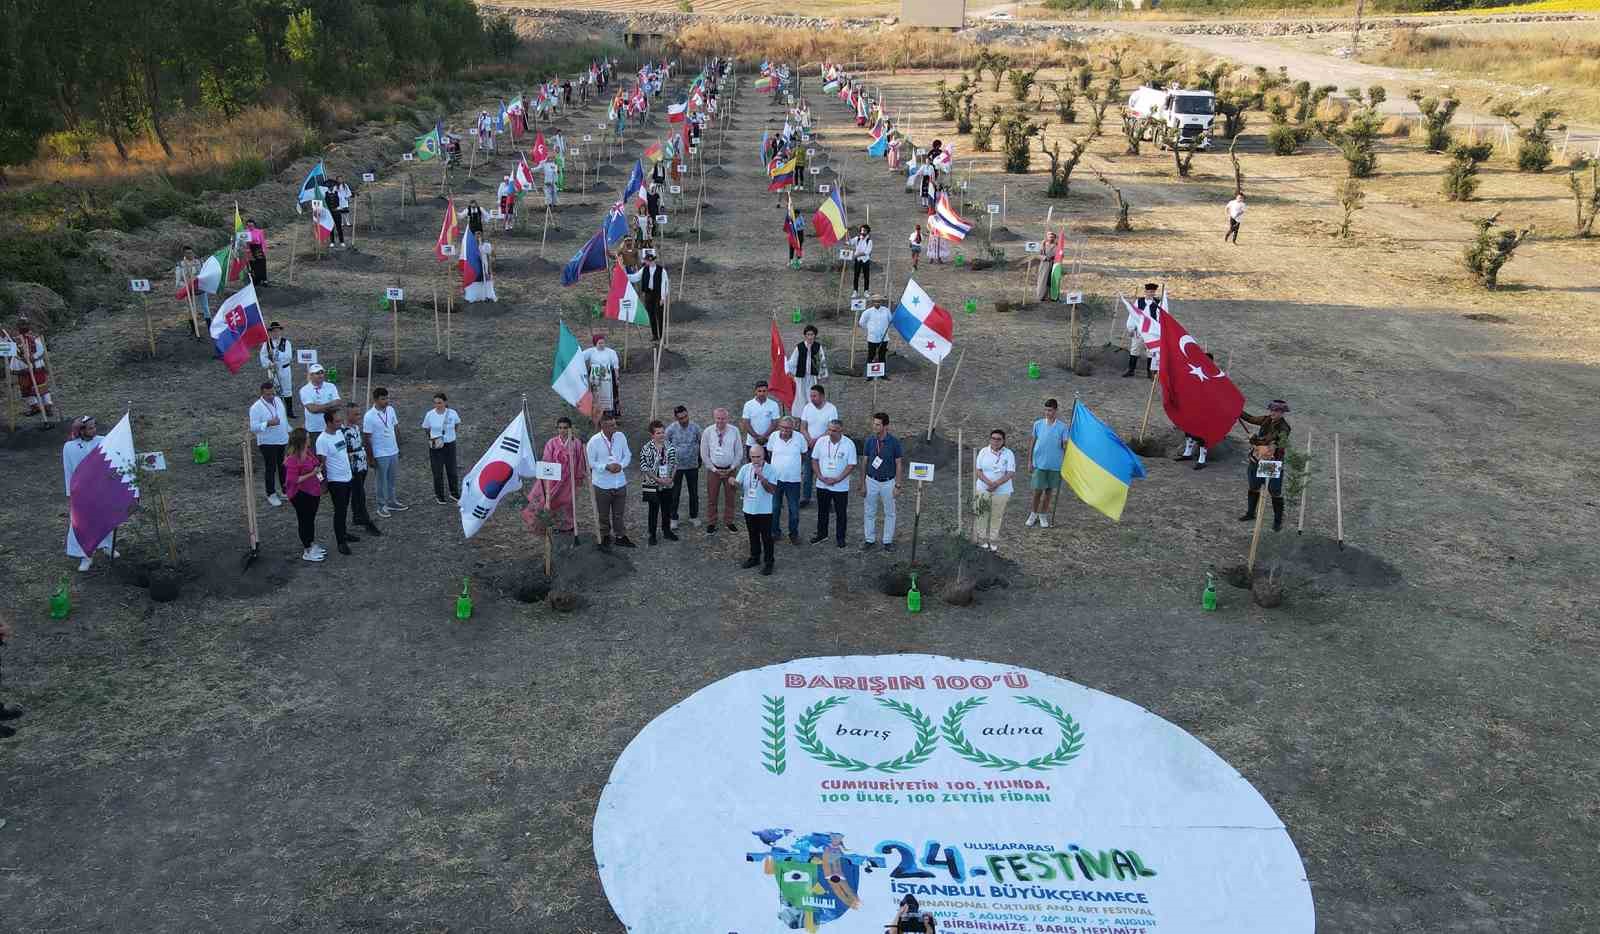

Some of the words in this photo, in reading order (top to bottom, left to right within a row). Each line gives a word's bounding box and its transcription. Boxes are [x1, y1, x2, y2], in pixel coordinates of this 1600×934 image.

[785, 673, 926, 695] BARIŞIN
[836, 724, 891, 740] barış
[982, 724, 1044, 736] adına
[821, 778, 939, 791] CUMHURİYETİN
[946, 780, 981, 791] 100.
[984, 779, 1051, 791] YILINDA,
[820, 792, 850, 803] 100
[856, 790, 899, 804] ÜLKE,
[907, 792, 935, 803] 100
[941, 790, 995, 803] ZEYTİN
[1000, 789, 1051, 803] FİDANI
[964, 842, 1055, 852] ULUSLARARASI
[890, 879, 984, 898] İSTANBUL
[990, 883, 1149, 904] BÜYÜKÇEKMECE
[893, 897, 988, 910] IRNATIONAL
[992, 902, 1040, 912] CULTURE
[1045, 904, 1073, 912] AND
[1077, 905, 1099, 914] ART
[1102, 906, 1154, 916] FESTIVAL
